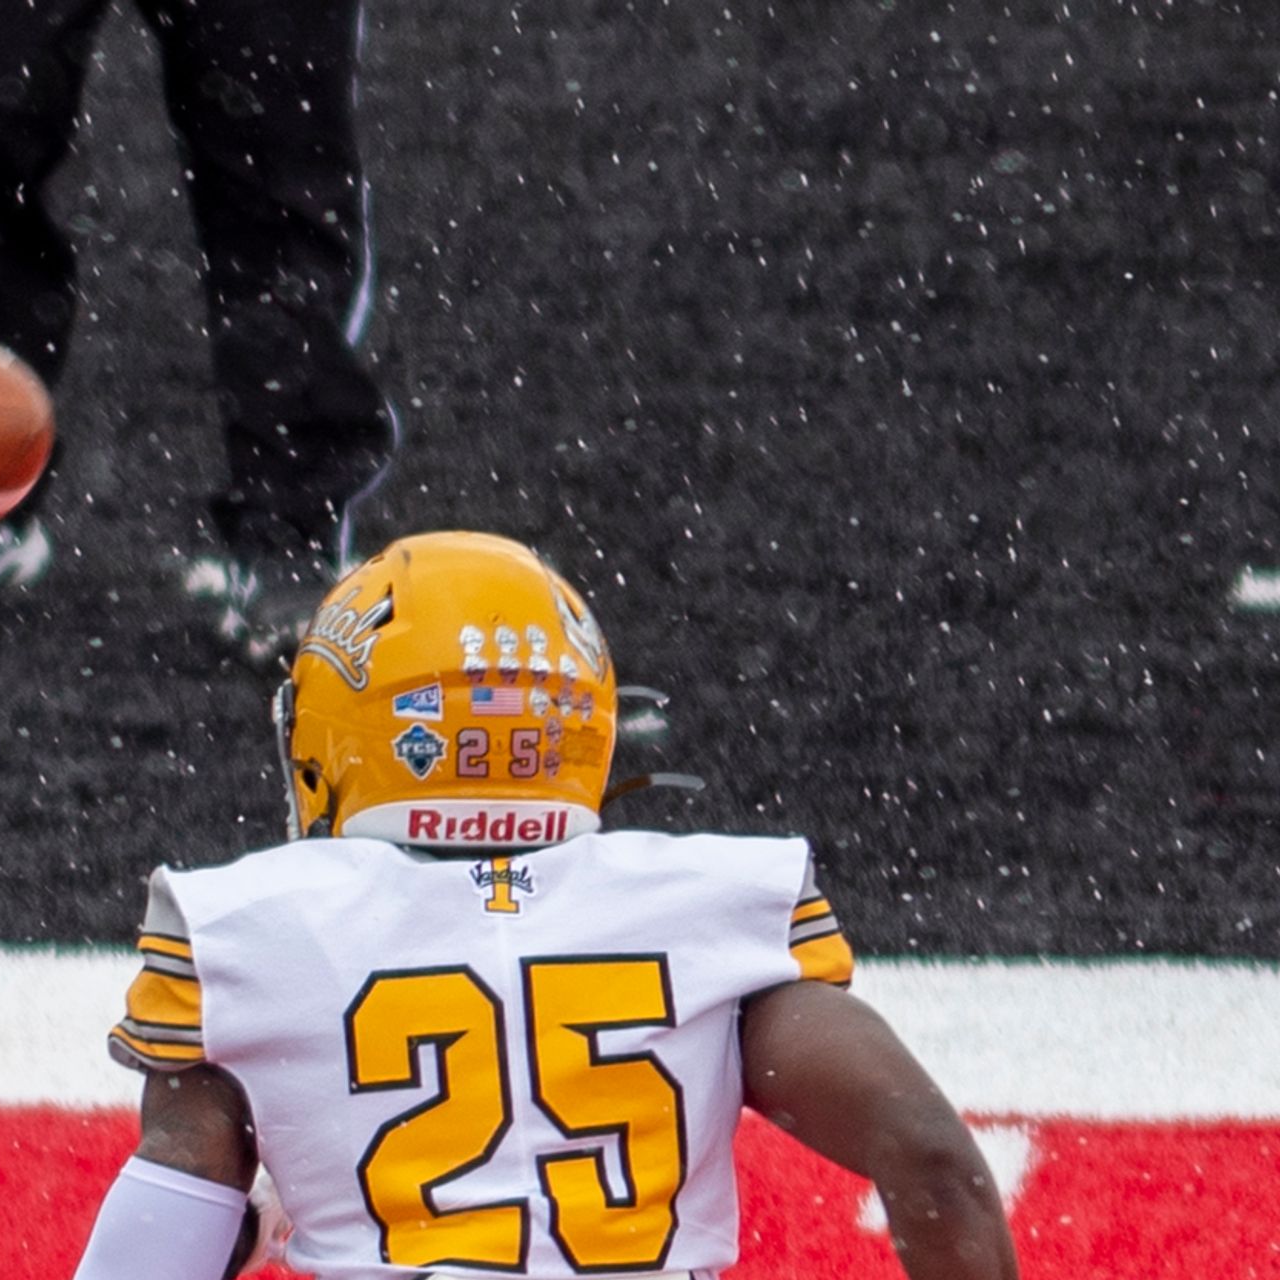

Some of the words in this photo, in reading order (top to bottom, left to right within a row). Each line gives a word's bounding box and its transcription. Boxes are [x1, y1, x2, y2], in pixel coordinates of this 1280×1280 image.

[401, 742, 437, 754] FCS
[457, 727, 540, 777] 25
[408, 809, 568, 842] Riddell
[469, 862, 533, 893] Vandals
[343, 952, 688, 1275] 25
